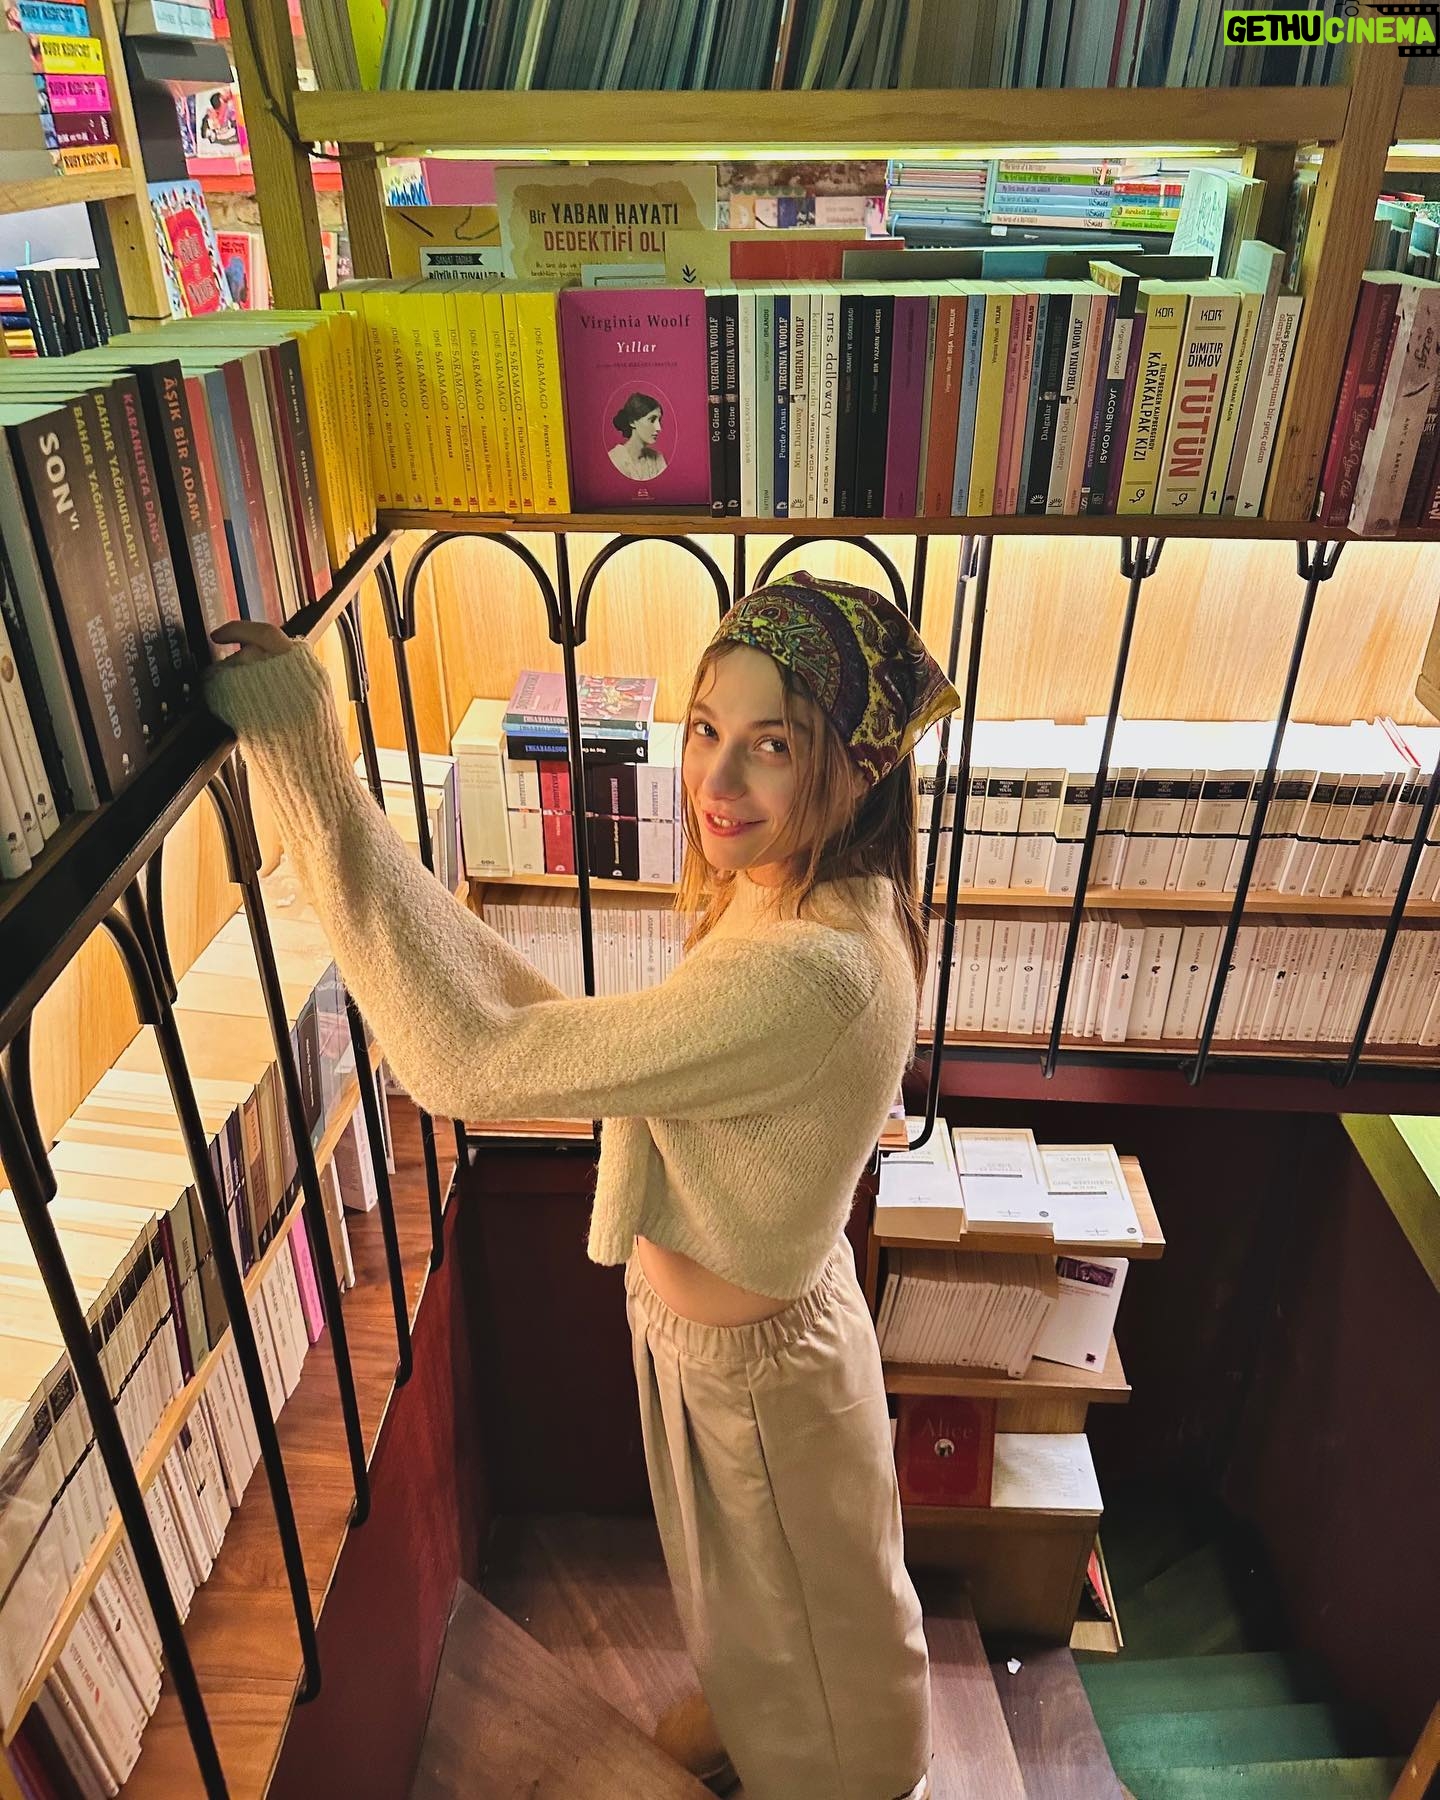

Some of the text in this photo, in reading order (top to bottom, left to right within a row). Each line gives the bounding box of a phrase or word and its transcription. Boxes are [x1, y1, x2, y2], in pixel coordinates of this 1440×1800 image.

[530, 203, 679, 225] Bir YABAN HAYATI
[544, 226, 634, 252] DEDEKTİFİ
[580, 314, 691, 332] Virginia Woolf
[709, 316, 719, 349] WOOLF
[726, 316, 736, 349] WOOLF
[778, 316, 788, 349] WOOLF
[796, 316, 805, 349] WOOLF
[826, 312, 835, 348] mrs.
[1072, 317, 1084, 349] WOOLF
[1285, 313, 1296, 338] james
[617, 341, 657, 353] Yıllar
[1267, 313, 1286, 378] olarak portresi
[1279, 337, 1290, 362] joyce
[374, 349, 389, 408] SARAMAGO
[394, 349, 408, 409] SARAMAGO
[415, 351, 428, 410] SARAMAGO
[436, 352, 449, 411] SARAMAGO
[452, 352, 465, 410] SARAMAGO
[471, 351, 485, 411] SARAMAGO
[496, 353, 507, 412] SARAMAGO
[510, 352, 522, 411] SARAMAGO
[536, 350, 549, 410] SARAMAGO
[709, 349, 719, 391] VIRGINIA
[727, 349, 736, 391] VIRGINIA
[778, 349, 788, 391] VIRGINIA
[795, 350, 804, 391] VIRGINIA
[821, 352, 837, 419] dalloway
[1066, 349, 1079, 391] VIRGINIA
[94, 394, 116, 452] BAHAR
[794, 406, 804, 448] Dalloway
[1041, 404, 1052, 441] Dalgalar
[1099, 387, 1118, 464] JACOB'IN ODASI
[1132, 351, 1162, 462] KARAKALPAK KIZI
[1168, 372, 1219, 478] TÜTÜN
[73, 406, 94, 466] BAHAR
[779, 433, 787, 459] Perde
[1257, 441, 1267, 464] adam
[39, 432, 75, 515] SON
[123, 393, 161, 547] KARANLIKTA DANS
[181, 466, 200, 524] ADAM
[199, 530, 212, 567] KARL
[137, 572, 152, 611] KARL
[160, 556, 176, 593] KARL
[191, 534, 218, 630] KNAUSGAAR
[93, 614, 118, 688] KARL OVE
[130, 576, 161, 689] KNAUSGAARD
[86, 618, 123, 740] KNAUSGAARD
[920, 1417, 976, 1439] Alice
